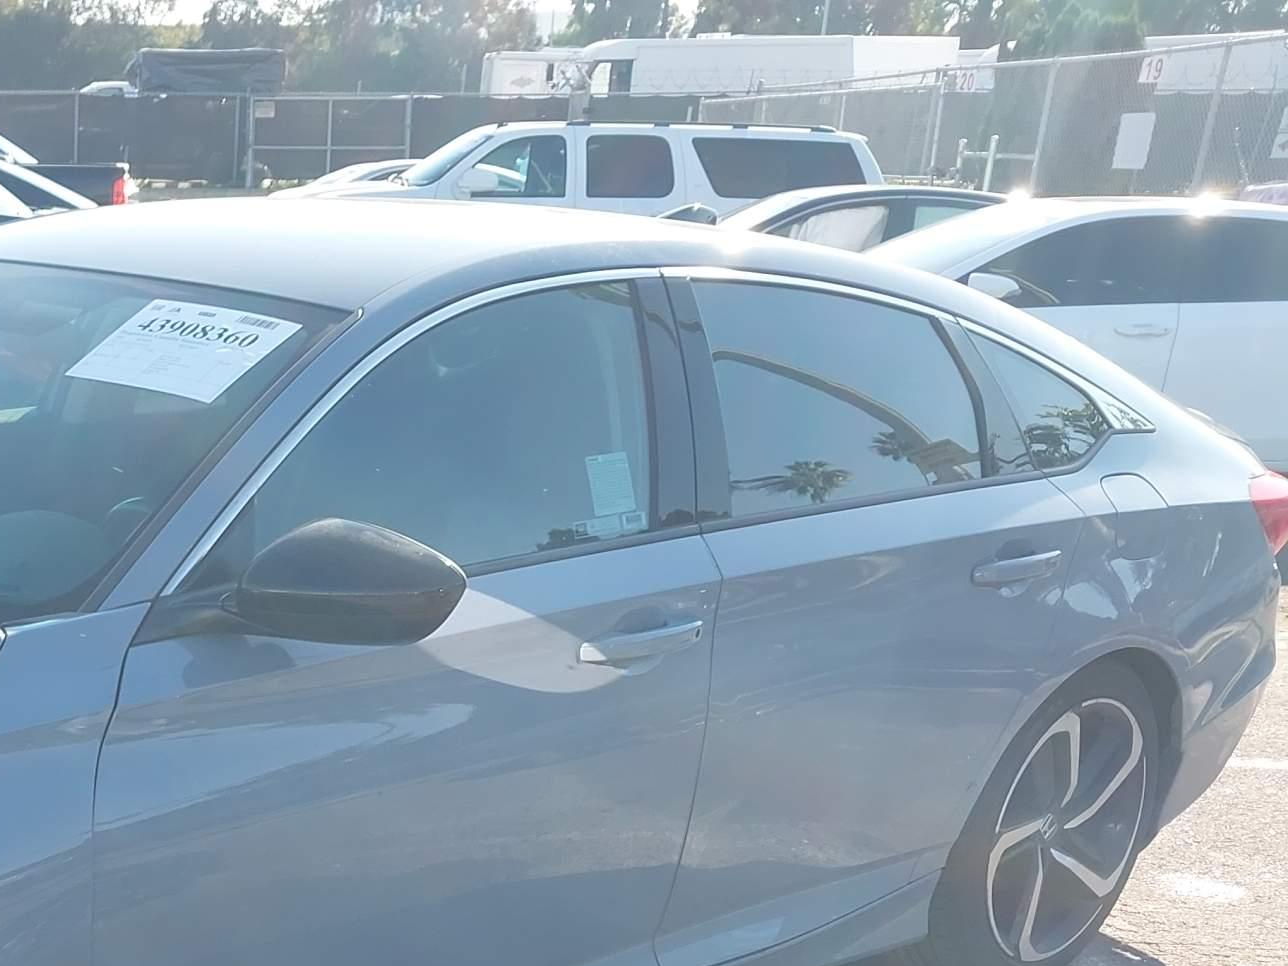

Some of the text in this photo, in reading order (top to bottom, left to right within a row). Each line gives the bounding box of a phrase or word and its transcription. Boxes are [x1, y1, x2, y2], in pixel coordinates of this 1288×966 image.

[1145, 58, 1164, 81] 19
[959, 72, 975, 91] 20
[137, 317, 260, 349] 43908360
